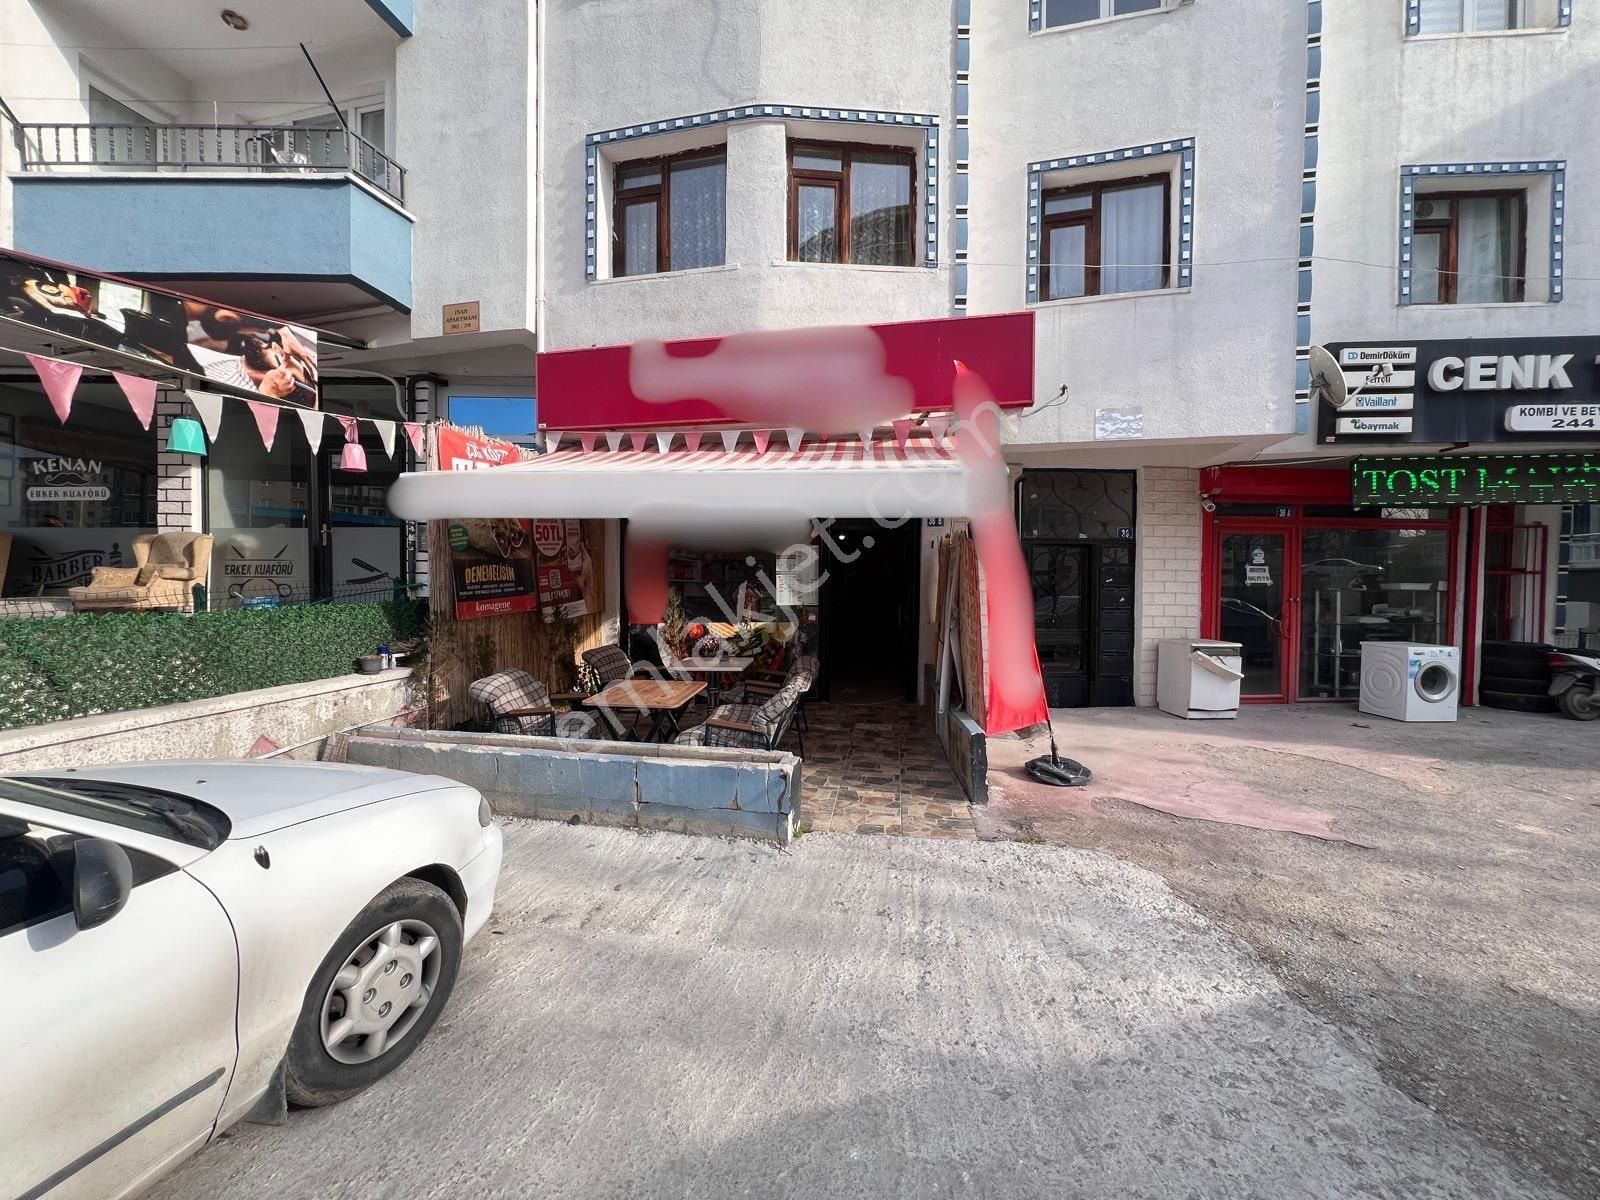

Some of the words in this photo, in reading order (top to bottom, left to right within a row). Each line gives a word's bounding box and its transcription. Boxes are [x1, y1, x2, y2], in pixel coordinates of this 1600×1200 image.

[1360, 351, 1411, 360] DemirDöküm
[1428, 354, 1575, 392] CENK
[1365, 396, 1398, 407] Vaillant
[1519, 406, 1558, 417] KOMBİ
[1562, 407, 1577, 417] VE
[1360, 422, 1400, 432] baymak
[1551, 418, 1596, 429] 244
[32, 457, 102, 475] KENAN
[1362, 468, 1466, 497] TOST
[30, 490, 60, 498] ERKEK
[63, 488, 107, 498] KUAFÖRÜ
[32, 554, 104, 584] BARBER
[224, 563, 252, 576] ERKEK
[255, 561, 294, 576] KUAFÖRÜ
[475, 600, 511, 613] komagene
